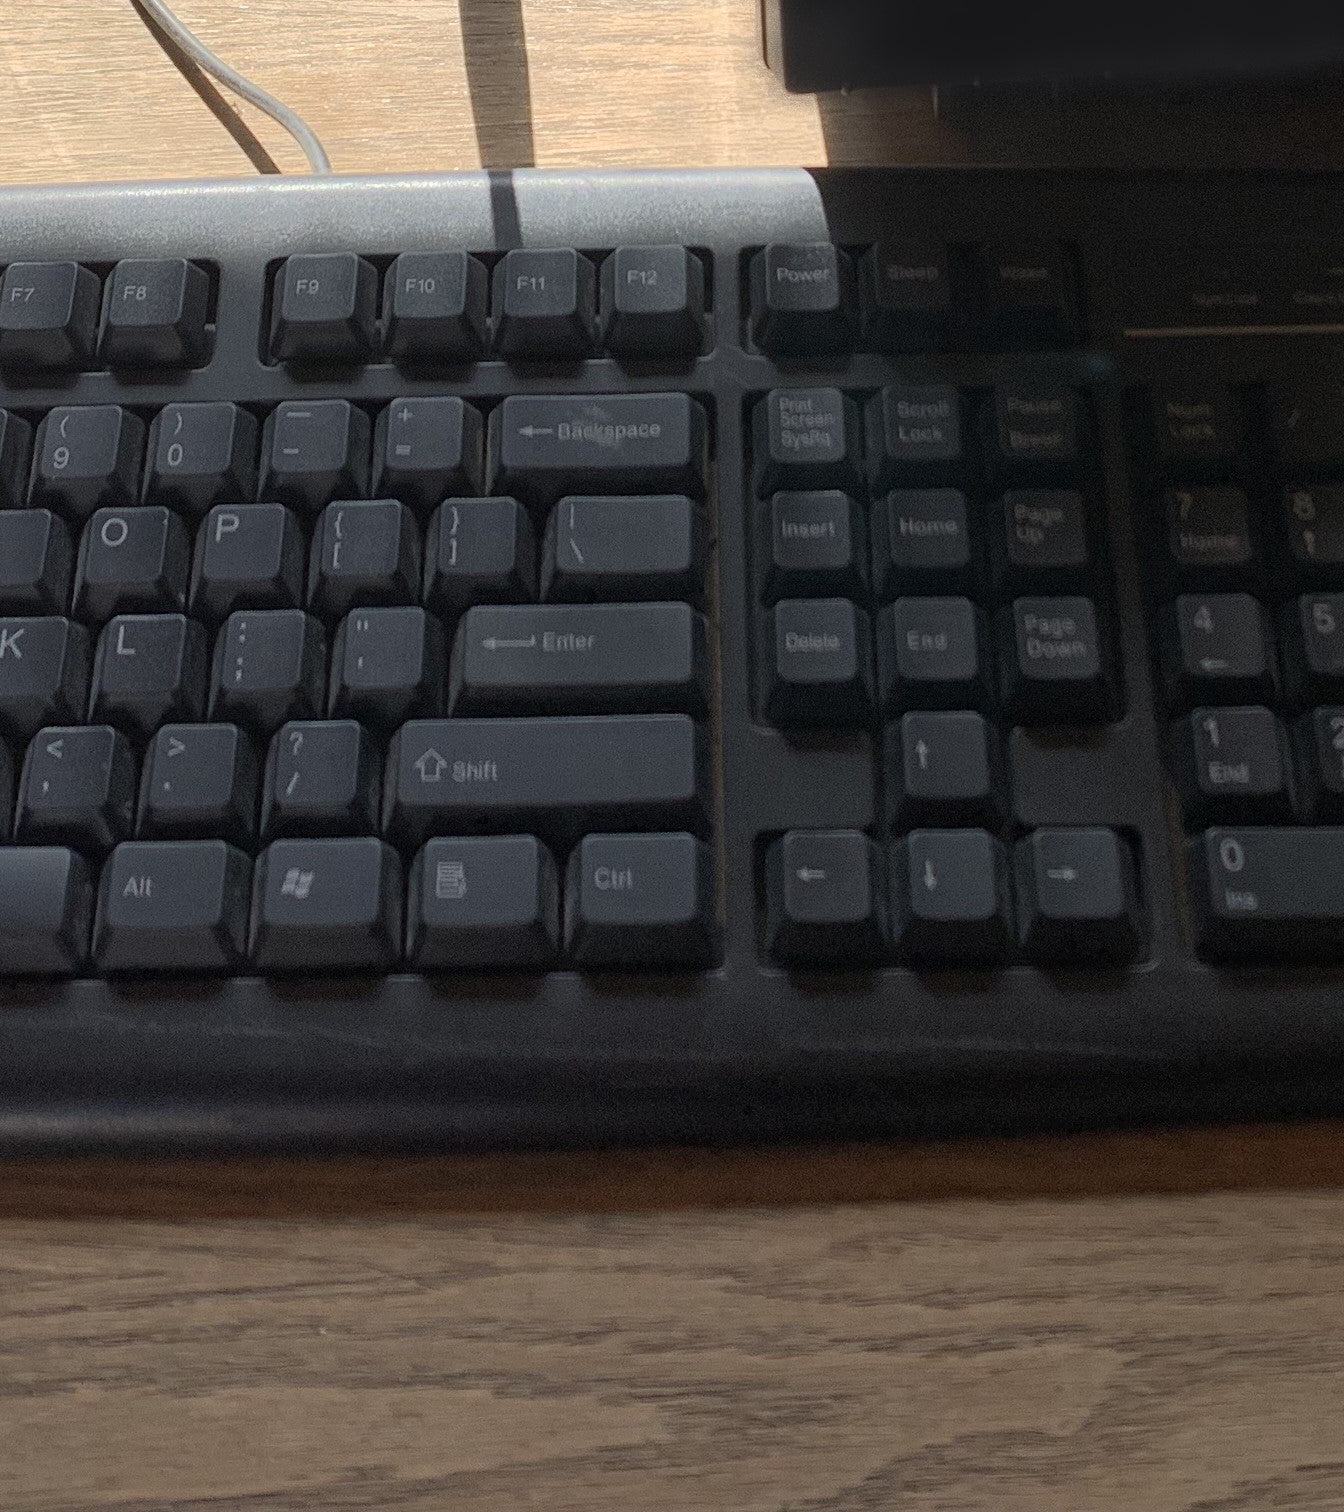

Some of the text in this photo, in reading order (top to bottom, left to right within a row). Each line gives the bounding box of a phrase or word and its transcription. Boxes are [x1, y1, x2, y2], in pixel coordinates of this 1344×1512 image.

[516, 277, 545, 291] F11
[627, 271, 657, 284] F12
[777, 267, 831, 283] Power
[11, 287, 34, 303] F7
[123, 285, 146, 300] F8
[296, 280, 319, 295] F9
[405, 279, 435, 294] F10
[780, 411, 834, 426] Screen
[897, 400, 950, 418] Scroll
[558, 422, 661, 440] Backspace
[898, 425, 943, 443] Lock
[53, 447, 70, 469] 9
[167, 444, 184, 467] 0
[1014, 504, 1063, 528] Page
[1175, 492, 1194, 520] 7
[1293, 491, 1316, 520] 8
[101, 518, 129, 547] O
[216, 514, 240, 542] P
[781, 519, 836, 539] Insert
[899, 517, 958, 536] Home
[1015, 526, 1044, 545] Up
[1024, 613, 1076, 639] Page
[1193, 605, 1214, 633] 4
[1312, 603, 1335, 633] 5
[117, 624, 137, 656] L
[542, 630, 597, 652] Enter
[785, 631, 840, 652] Delete
[906, 631, 948, 651] End
[1027, 638, 1086, 659] Down
[1204, 718, 1221, 747] 1
[453, 760, 500, 784] Shift
[1209, 762, 1250, 783] End
[1219, 838, 1245, 872] 0
[123, 876, 153, 899] Alt
[593, 866, 635, 891] Ctrl
